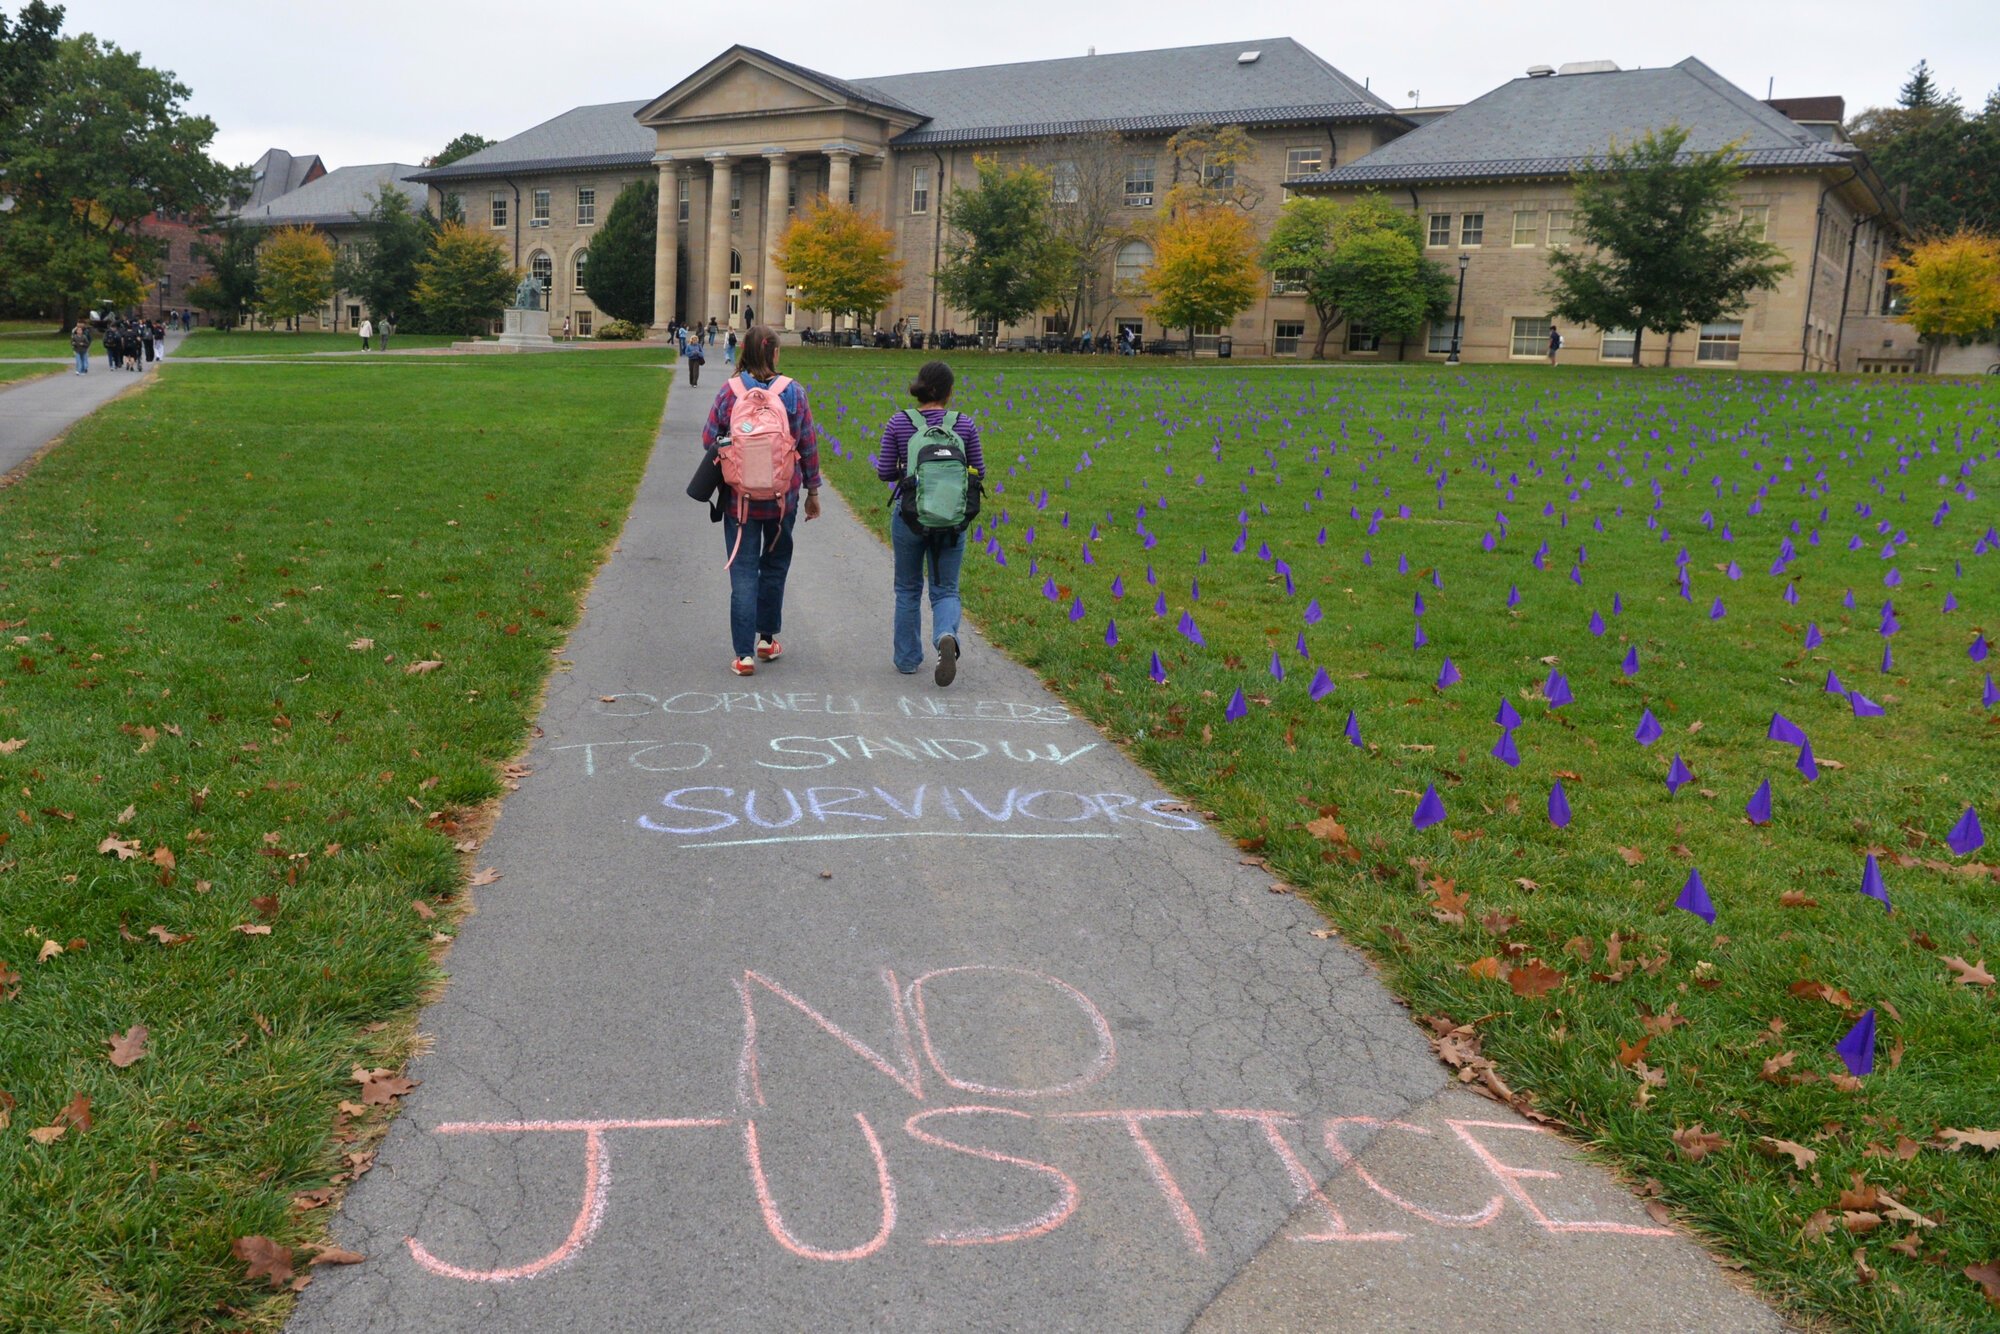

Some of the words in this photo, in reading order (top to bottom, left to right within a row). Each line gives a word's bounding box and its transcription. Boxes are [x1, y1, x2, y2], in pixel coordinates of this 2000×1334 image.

[595, 691, 886, 716] CORNELL
[898, 695, 1072, 721] NEEDS
[549, 740, 712, 777] TO
[755, 735, 990, 770] STAND
[636, 784, 1204, 834] SURVIVORS
[731, 965, 1117, 1106] NO
[403, 1105, 1676, 1283] JUSTICE
